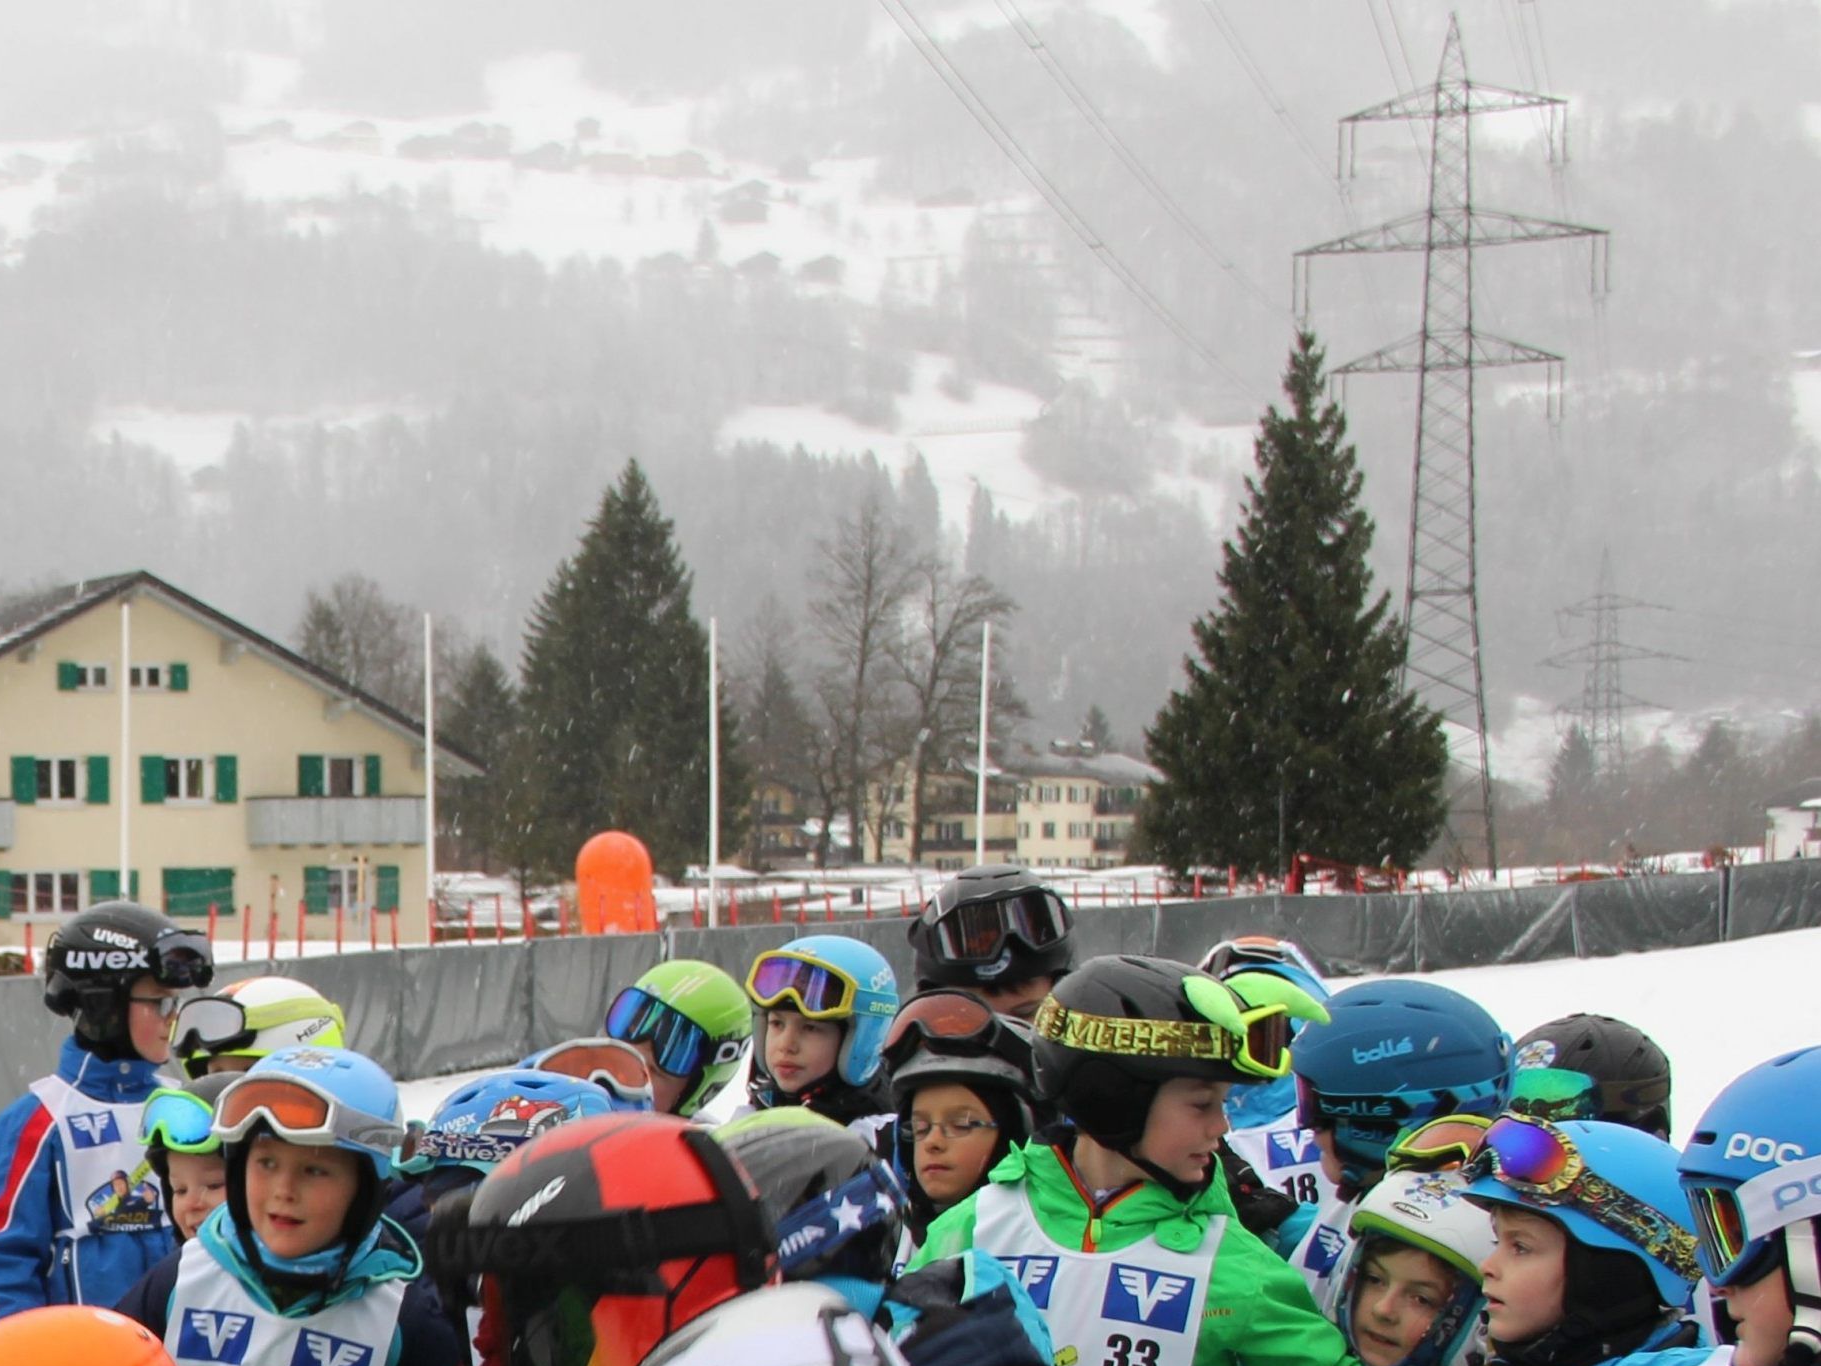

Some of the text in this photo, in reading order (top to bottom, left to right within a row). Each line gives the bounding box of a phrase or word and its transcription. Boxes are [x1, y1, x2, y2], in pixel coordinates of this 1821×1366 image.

[93, 927, 140, 951] uvex
[65, 949, 150, 970] uvex
[1351, 1035, 1415, 1065] bollé
[1319, 1100, 1393, 1116] bollé
[445, 1142, 508, 1163] uvex
[1281, 1172, 1320, 1204] 18
